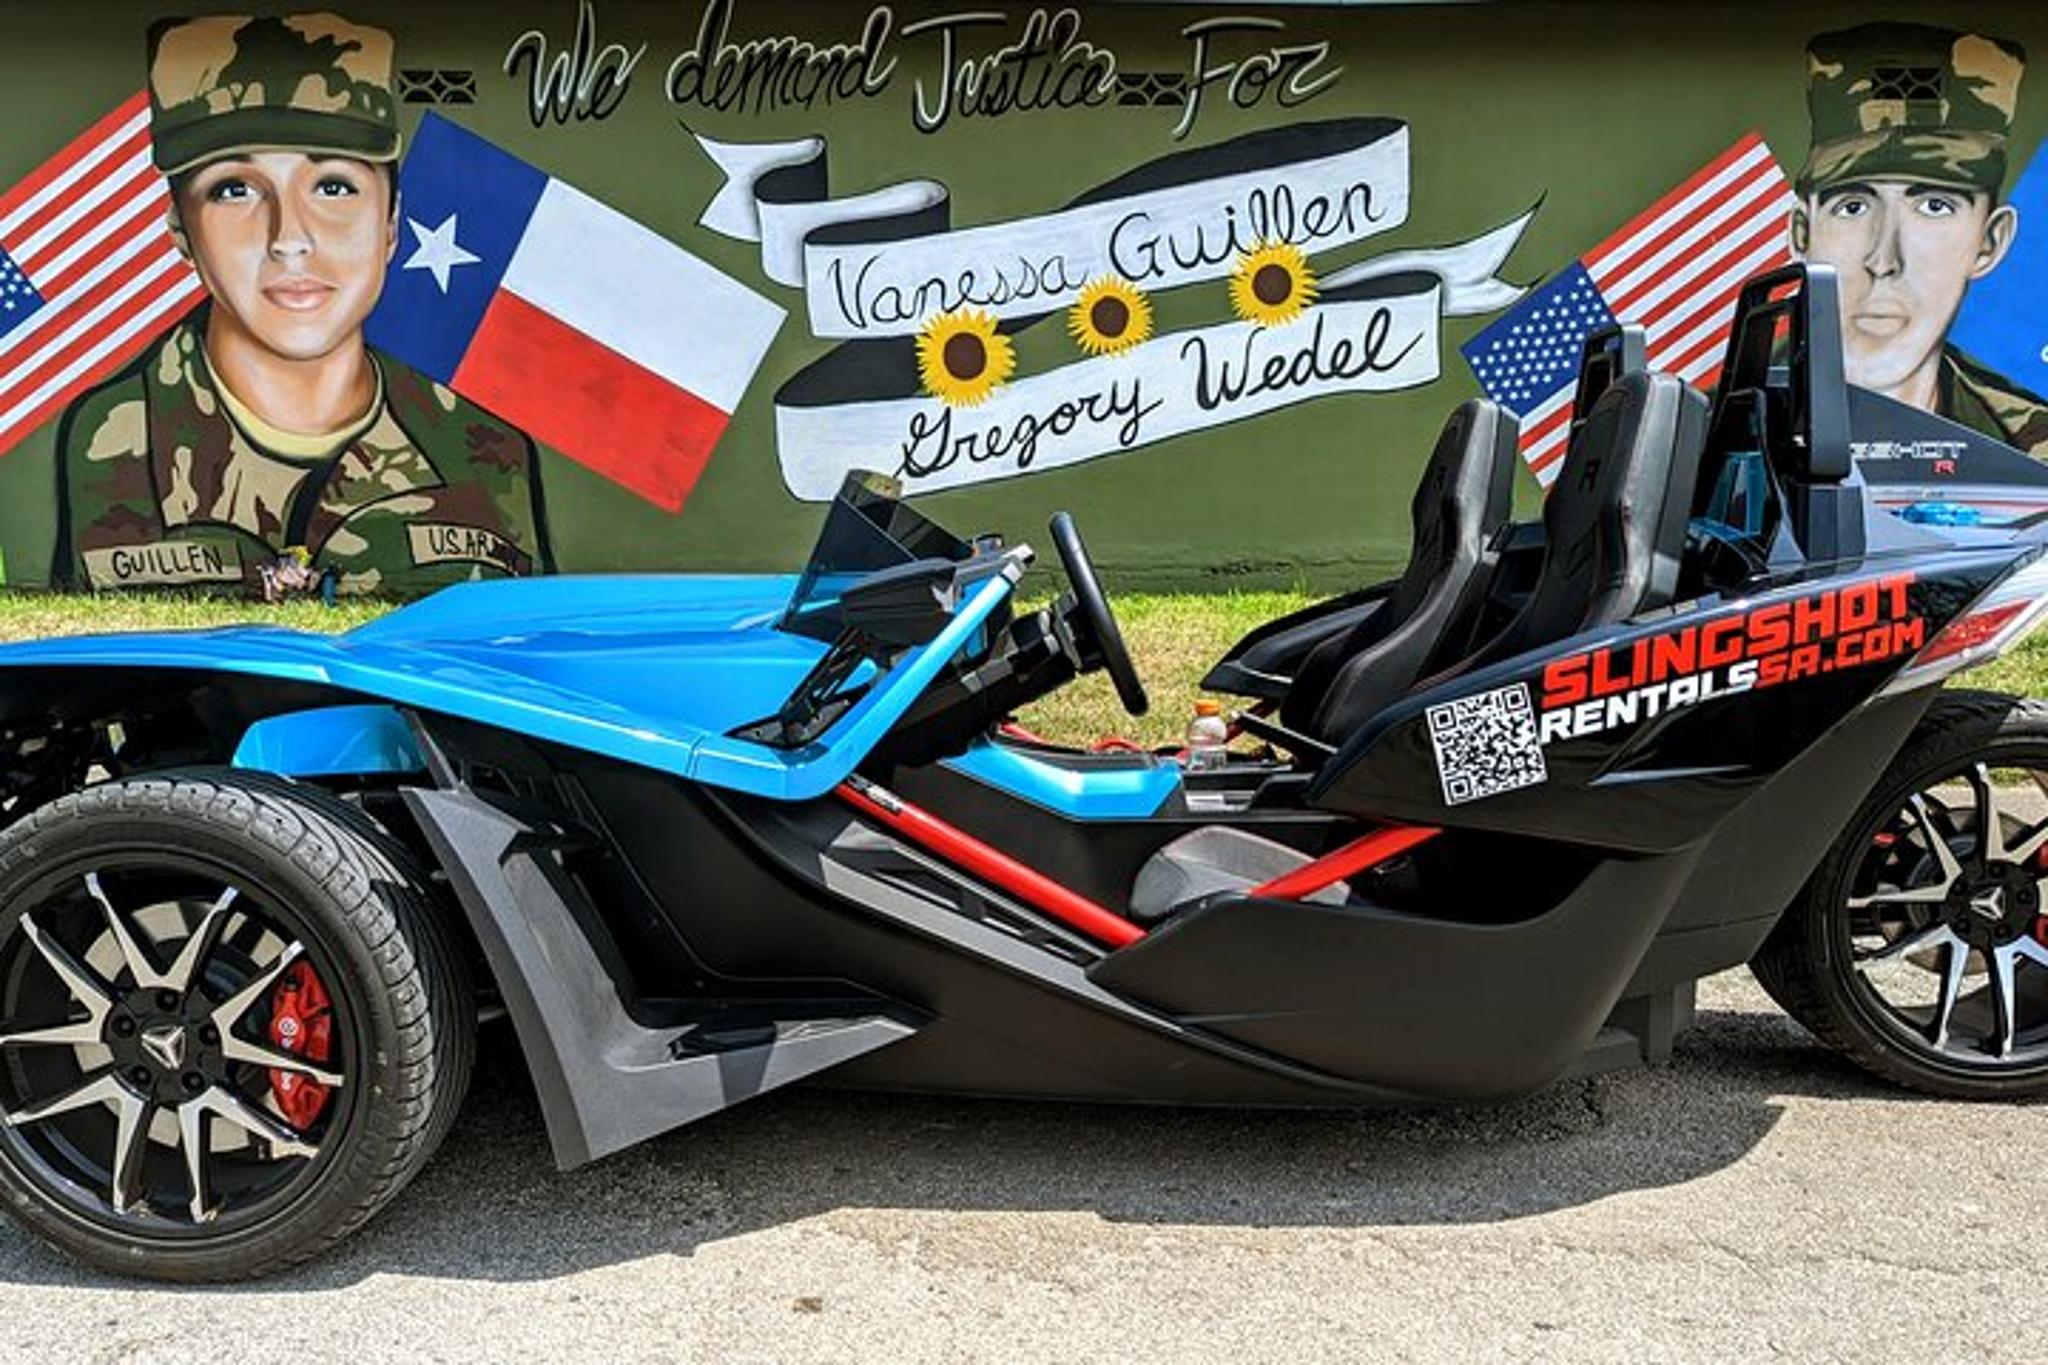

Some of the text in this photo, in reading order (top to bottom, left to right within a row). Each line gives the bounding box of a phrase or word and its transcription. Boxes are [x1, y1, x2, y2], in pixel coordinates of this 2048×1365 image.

[503, 0, 1343, 140] We demand Justice For
[826, 181, 1386, 329] Vanessa Guillen
[894, 305, 1426, 479] Gregory Wedel
[112, 546, 223, 579] GUILLEN
[1541, 573, 1916, 708] SLINGSHOT
